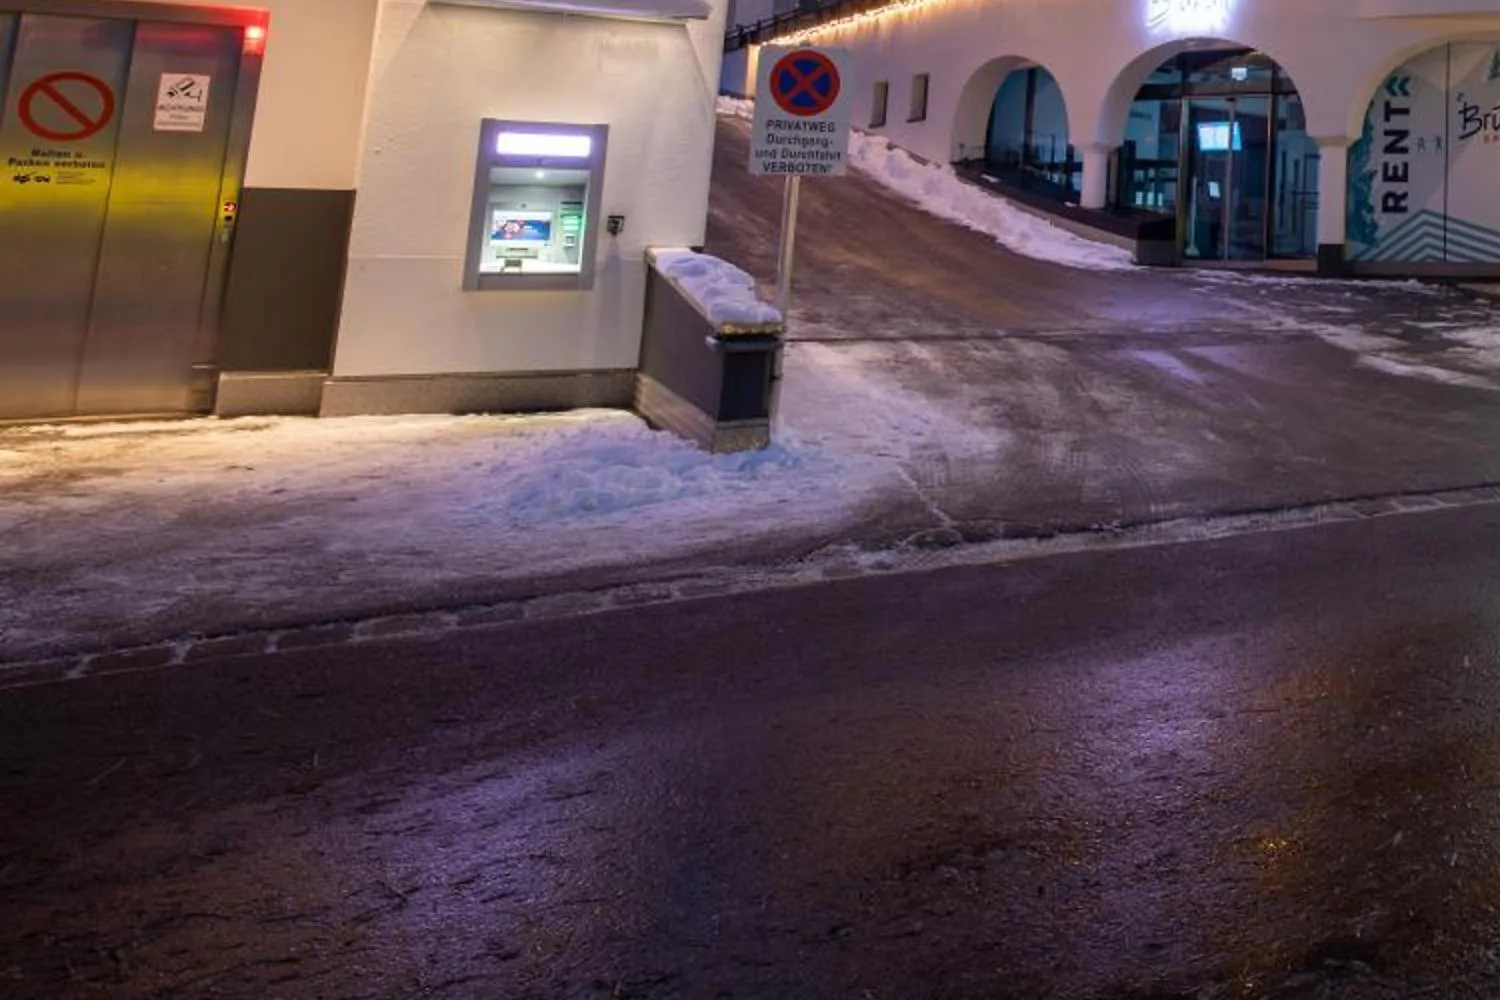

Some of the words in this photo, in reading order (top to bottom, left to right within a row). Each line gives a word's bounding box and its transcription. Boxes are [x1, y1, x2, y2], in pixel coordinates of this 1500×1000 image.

[766, 119, 836, 133] PRIVATWEG
[755, 148, 777, 159] und
[1382, 101, 1410, 213] RENT
